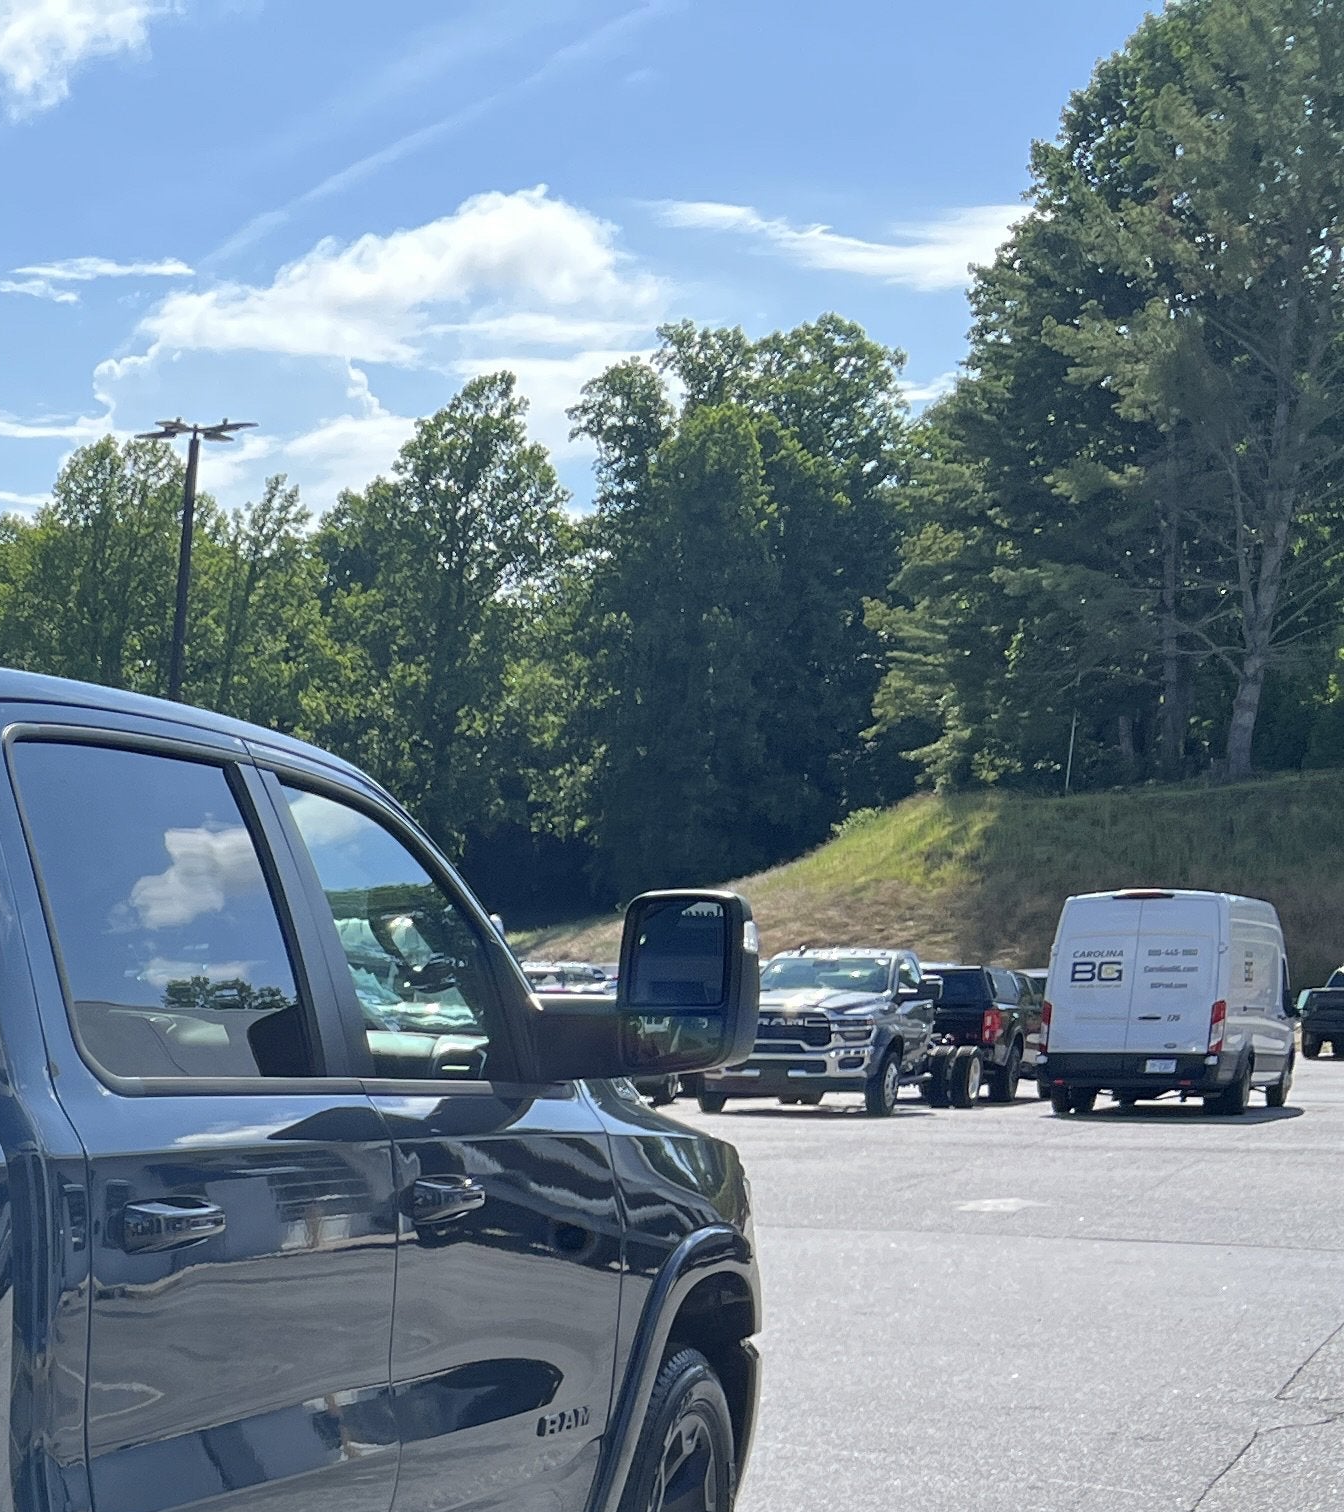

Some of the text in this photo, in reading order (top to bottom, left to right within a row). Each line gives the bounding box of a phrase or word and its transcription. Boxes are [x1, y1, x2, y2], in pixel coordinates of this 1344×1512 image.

[1072, 950, 1124, 959] CAROLINA
[1071, 961, 1123, 982] BG
[544, 1405, 591, 1434] RAM
